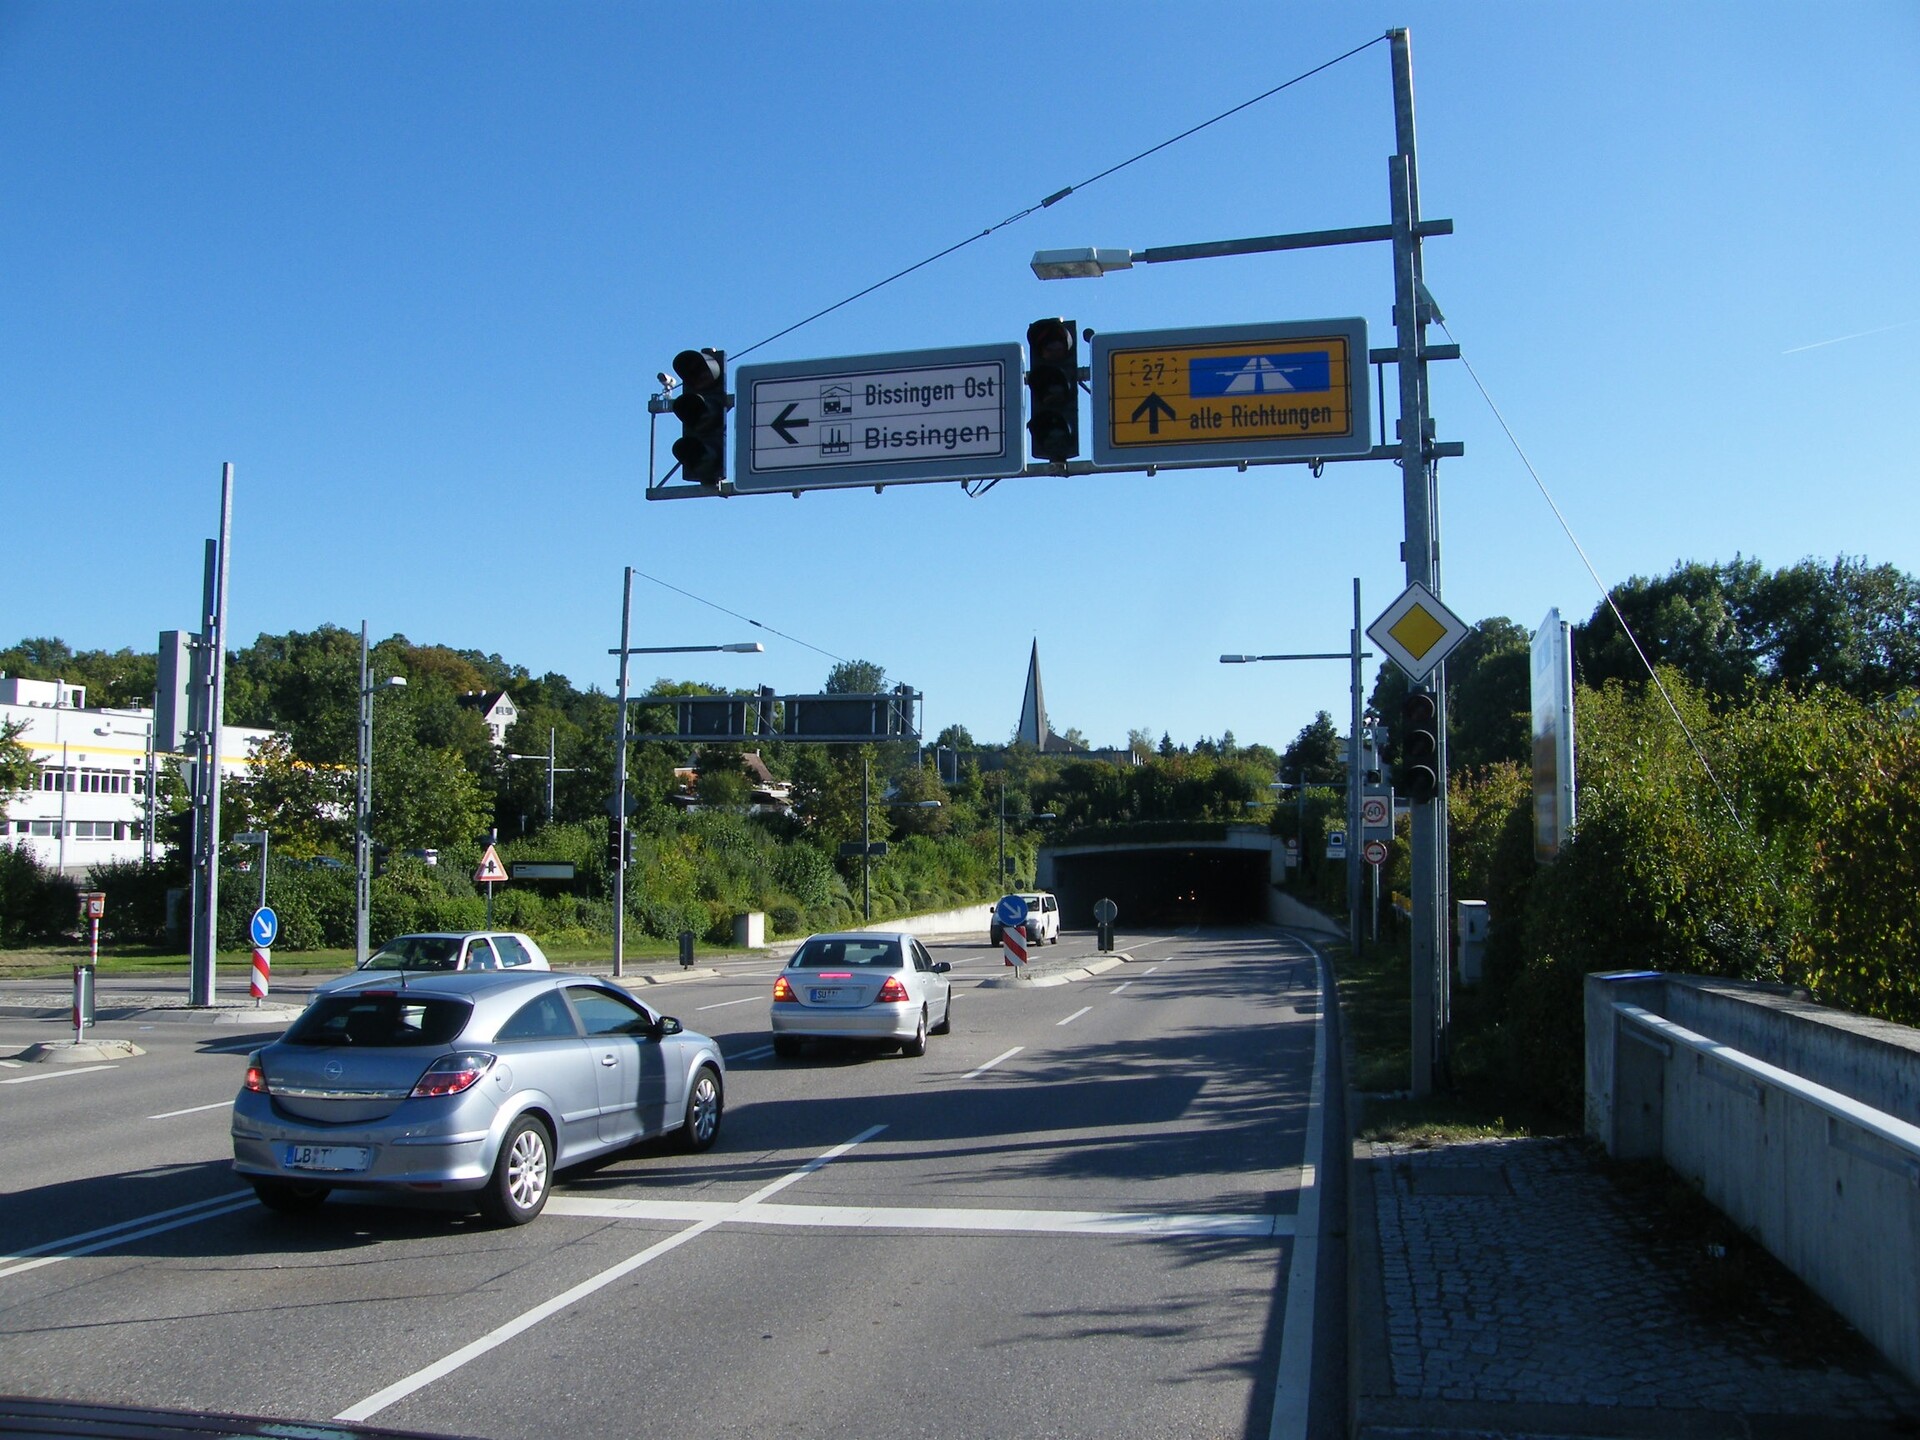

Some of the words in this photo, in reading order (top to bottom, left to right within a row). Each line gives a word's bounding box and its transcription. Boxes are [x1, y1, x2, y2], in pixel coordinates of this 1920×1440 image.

[1142, 362, 1165, 381] 27
[865, 382, 954, 407] Bissingen
[964, 376, 995, 399] Ost
[1190, 406, 1222, 429] alle
[1231, 403, 1332, 430] Richtungen
[865, 423, 990, 450] Bissingen
[1367, 806, 1381, 817] 60
[293, 1147, 312, 1164] LB
